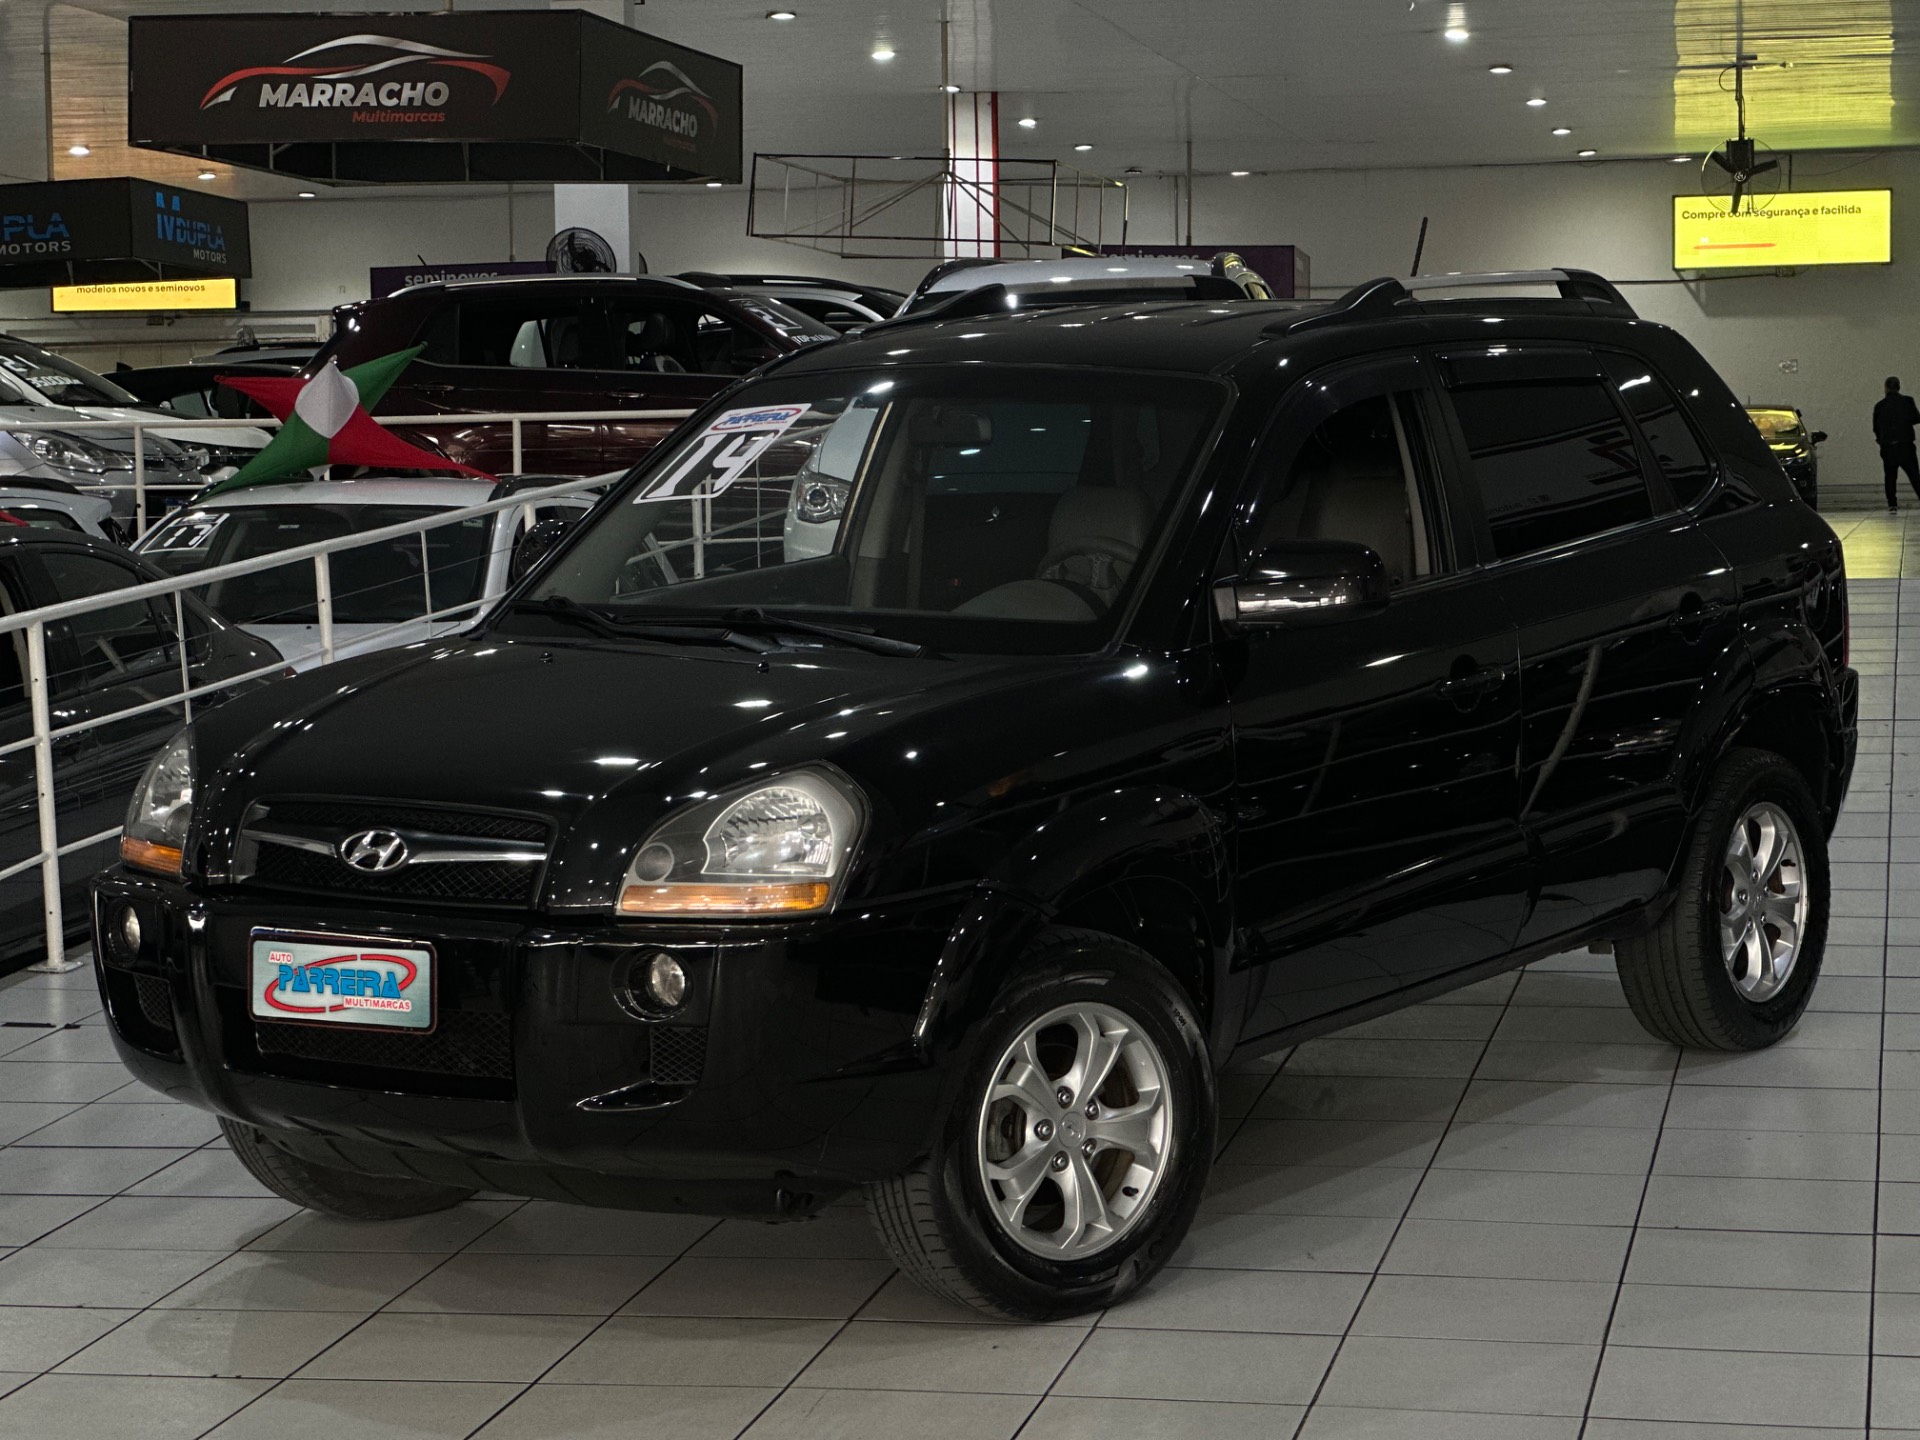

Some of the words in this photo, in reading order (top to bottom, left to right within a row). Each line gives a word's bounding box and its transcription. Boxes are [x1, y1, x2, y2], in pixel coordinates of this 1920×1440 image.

[259, 81, 450, 108] MARRACHO
[352, 109, 446, 123] Multimarcas
[628, 95, 698, 138] MARRACHO
[1681, 210, 1726, 220] Compre
[1753, 208, 1810, 219] segurança
[1820, 205, 1862, 216] facilida
[0, 240, 72, 256] MOTORS
[193, 248, 227, 264] MOTORS
[76, 284, 116, 293] modelos
[118, 285, 147, 293] novos
[155, 283, 205, 292] seminovos
[163, 524, 213, 548] 17
[269, 952, 292, 963] AUTO
[278, 964, 402, 999] PARREIRA
[344, 997, 411, 1011] MULTIMARCAS
